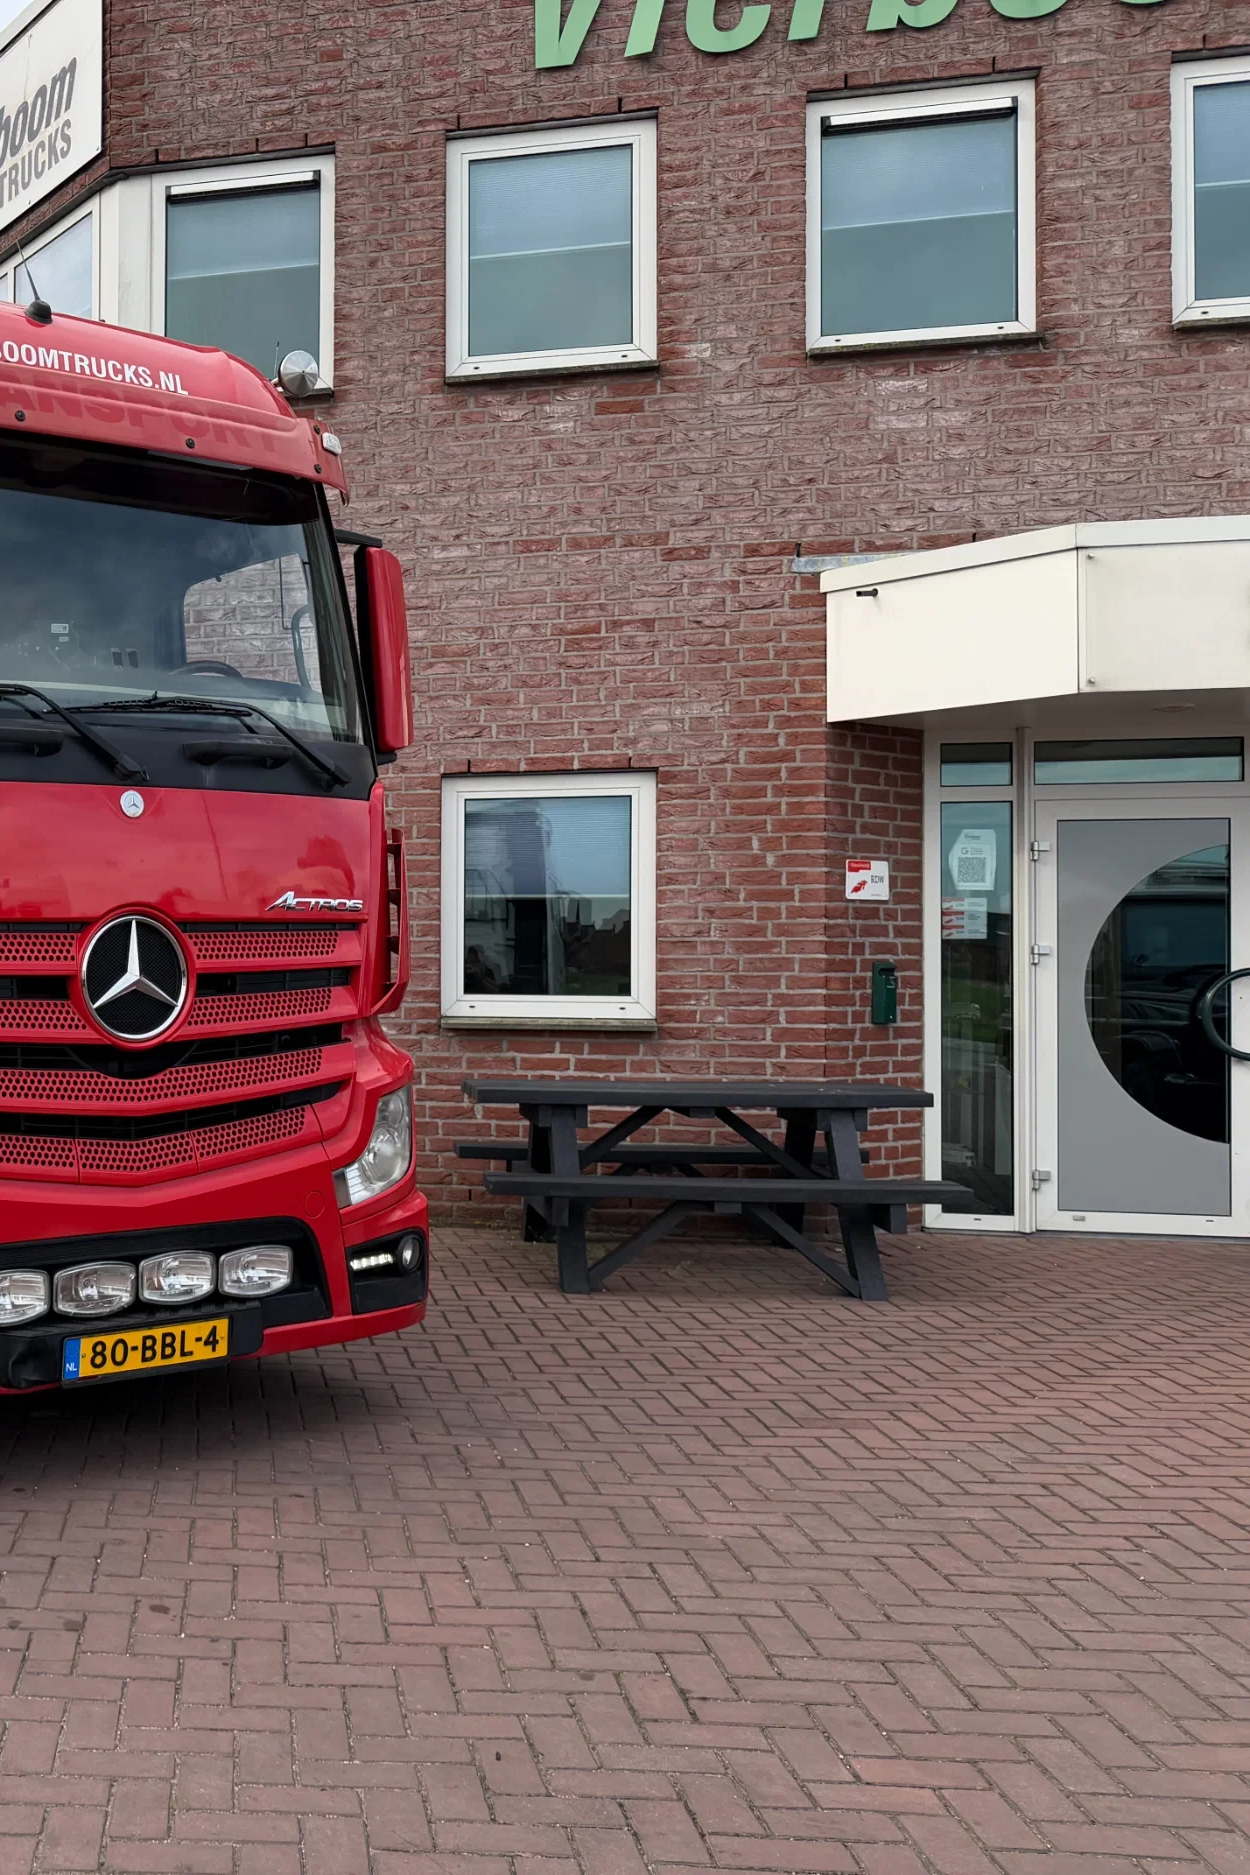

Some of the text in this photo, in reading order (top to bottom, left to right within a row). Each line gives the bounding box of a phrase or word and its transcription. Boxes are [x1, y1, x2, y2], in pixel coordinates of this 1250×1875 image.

[870, 875, 884, 883] RDW
[66, 1325, 220, 1371] NL 80-BBL-4
